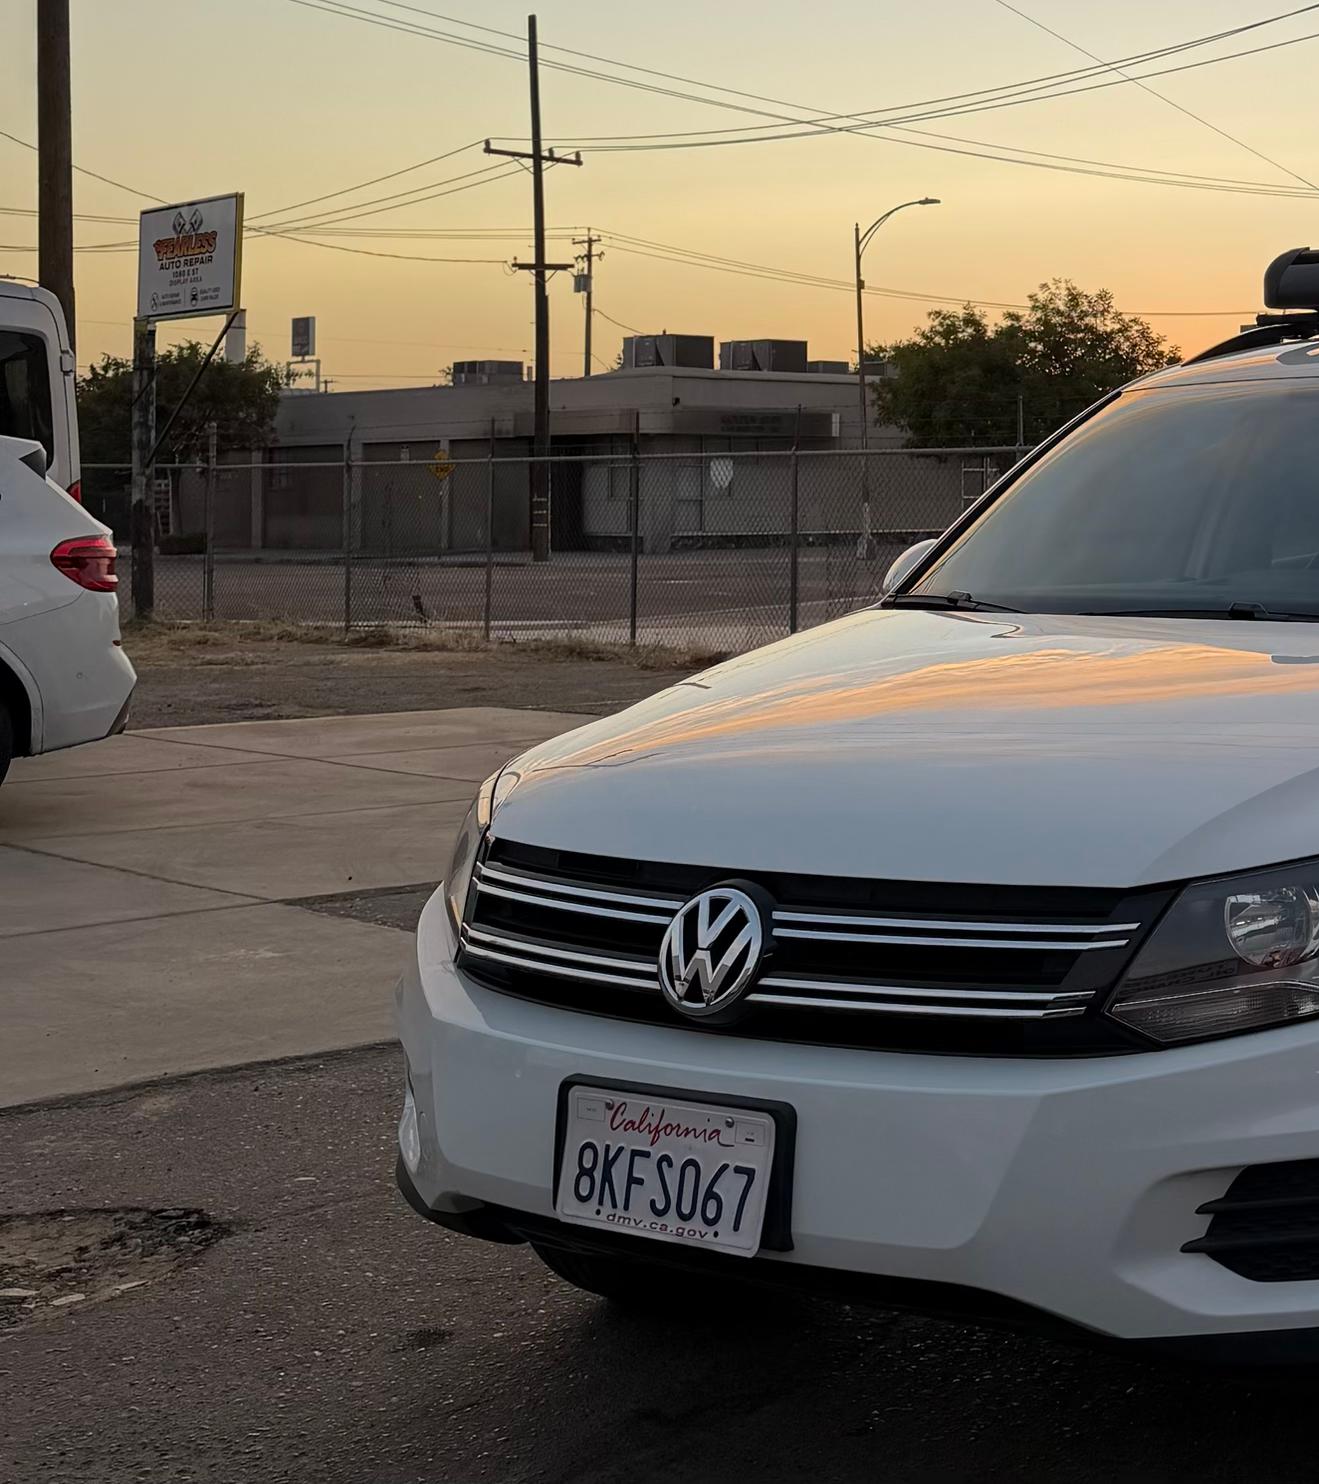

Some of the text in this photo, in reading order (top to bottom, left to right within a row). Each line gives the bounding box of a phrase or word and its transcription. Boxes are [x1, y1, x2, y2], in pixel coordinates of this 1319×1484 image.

[159, 255, 214, 271] AUTO REPAIR
[609, 1102, 735, 1147] California
[574, 1141, 756, 1233] 8KFS067
[606, 1213, 709, 1239] dmv.ca.gov
